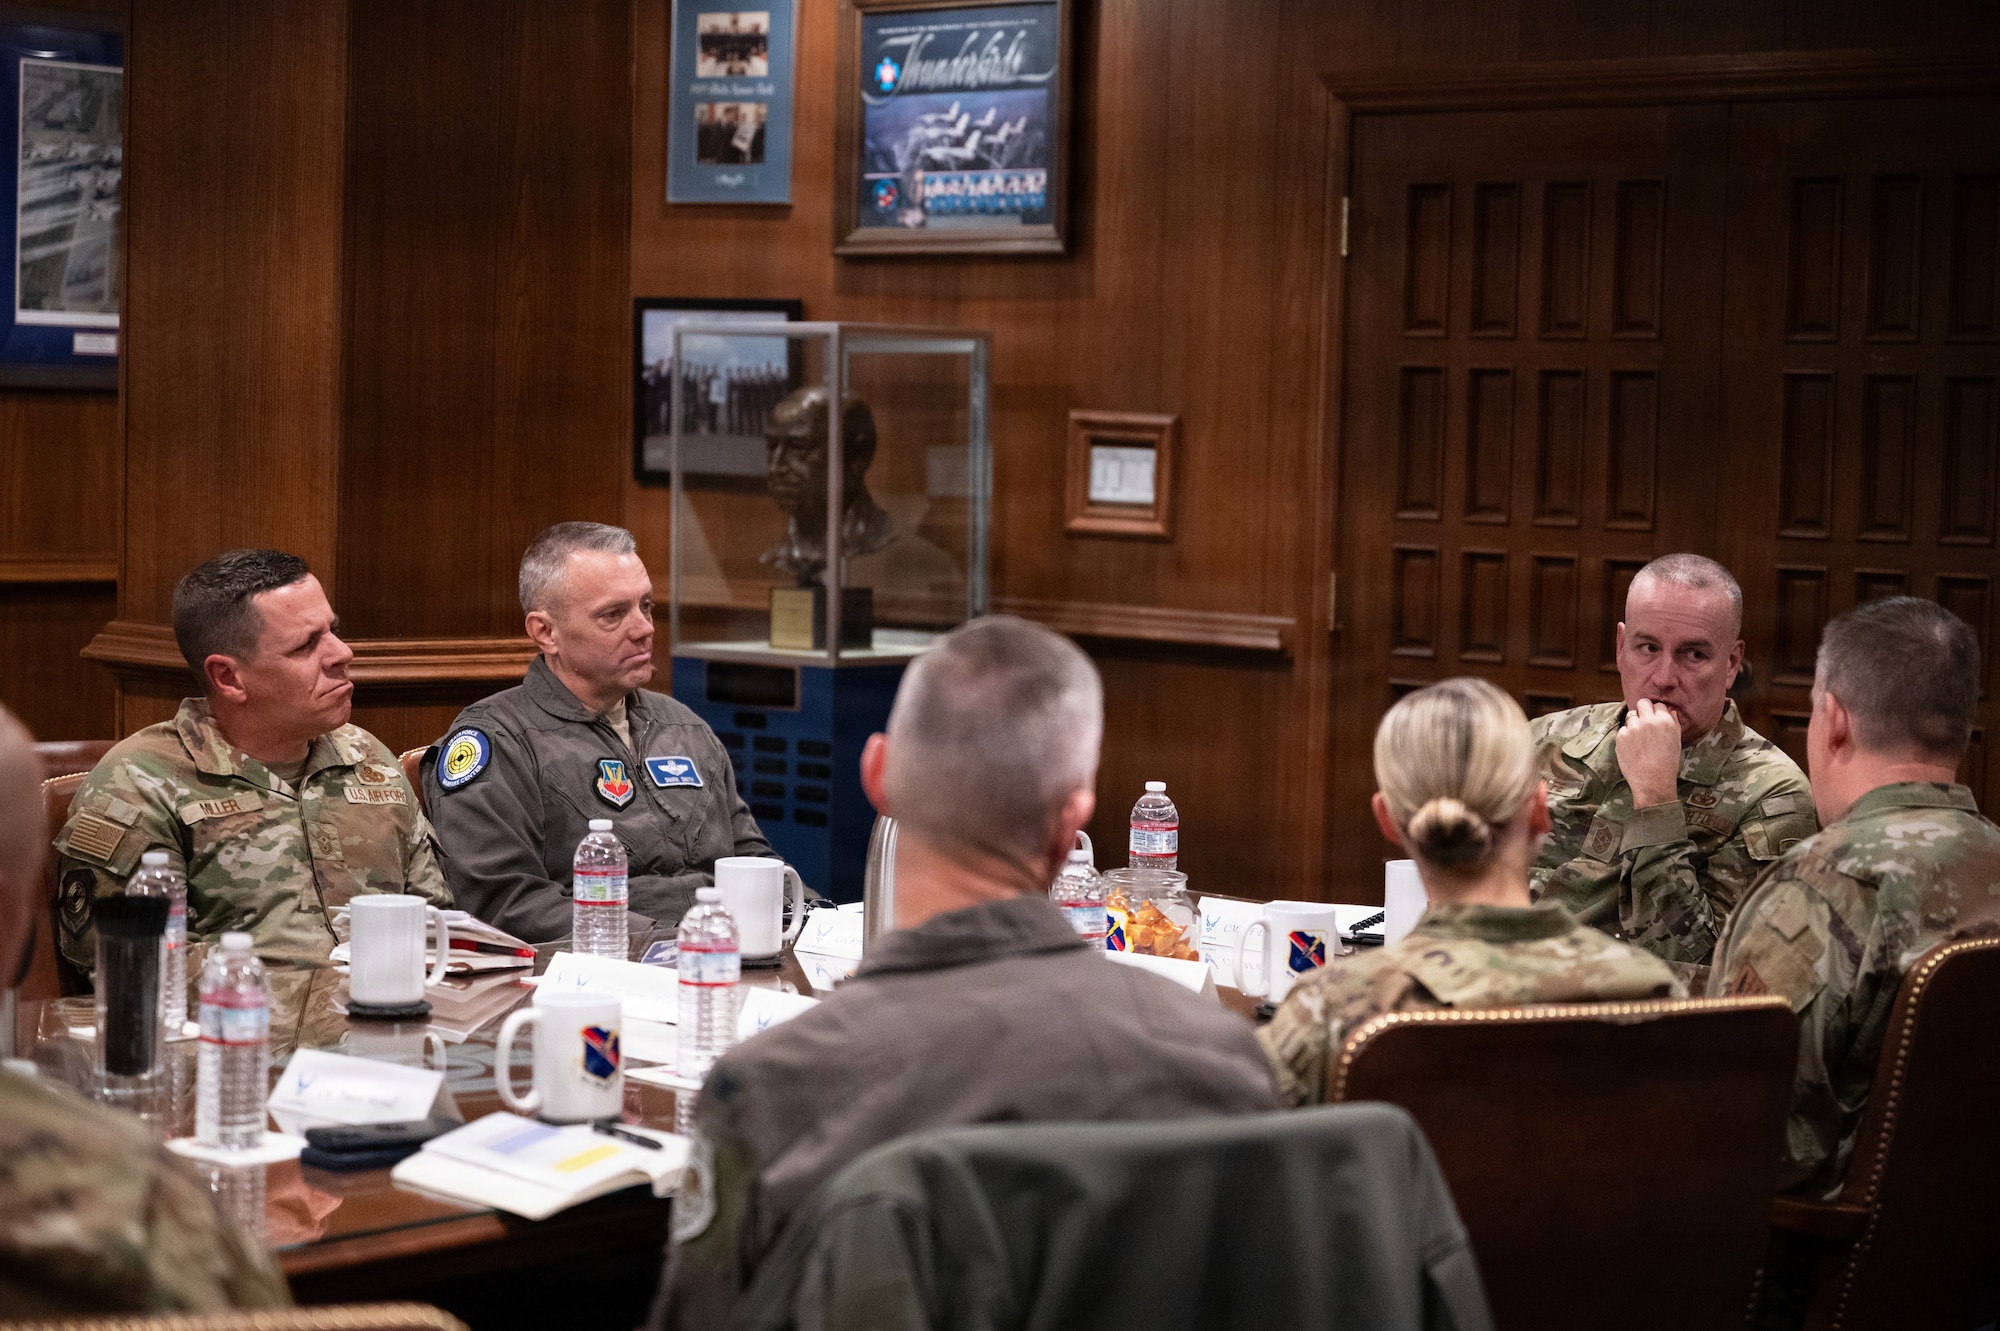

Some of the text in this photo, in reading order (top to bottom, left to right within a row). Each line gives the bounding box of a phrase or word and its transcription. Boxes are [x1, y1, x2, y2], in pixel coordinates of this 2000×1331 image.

[349, 788, 368, 801] U.S.
[368, 789, 385, 802] AIR
[199, 799, 241, 815] MILLER
